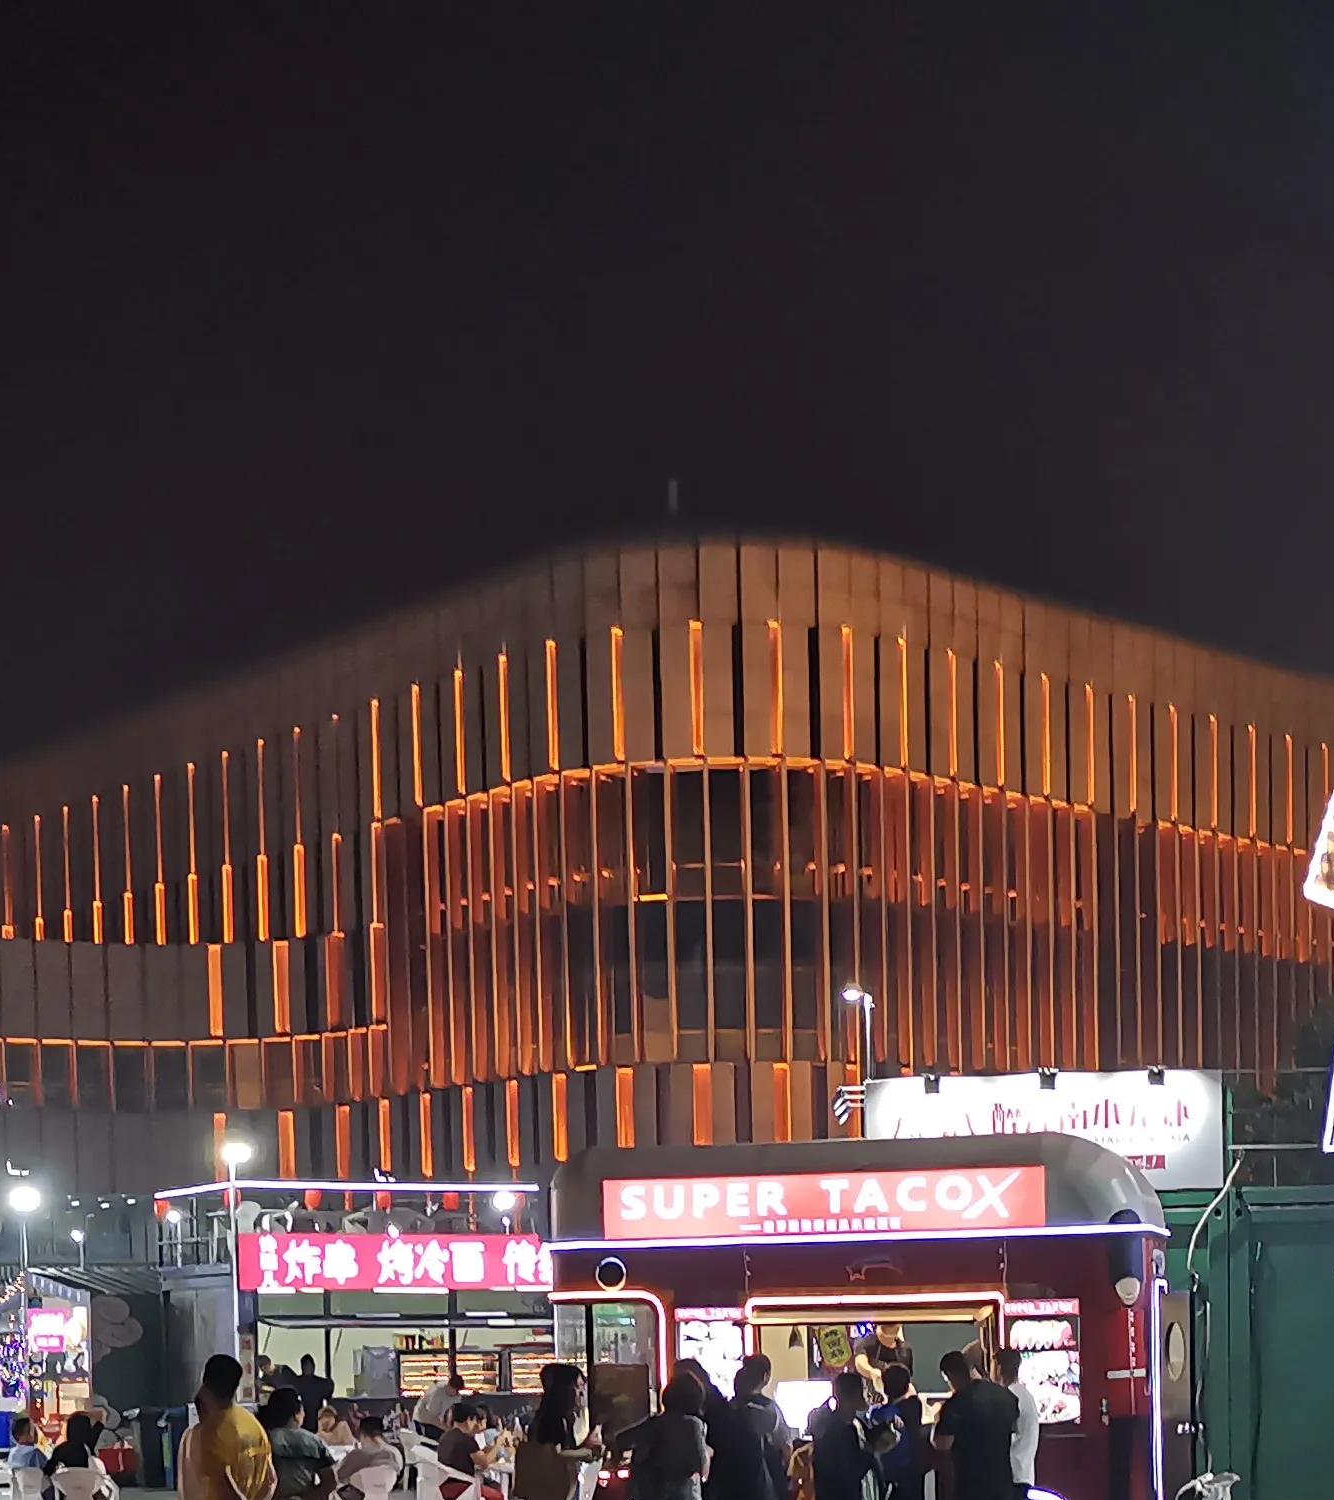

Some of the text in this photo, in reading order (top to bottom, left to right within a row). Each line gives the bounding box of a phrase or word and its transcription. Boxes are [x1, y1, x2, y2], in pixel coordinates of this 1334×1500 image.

[619, 1168, 1023, 1221] SUPER TACOX
[282, 1238, 360, 1286] 炸串
[376, 1237, 486, 1286] 烤冷面
